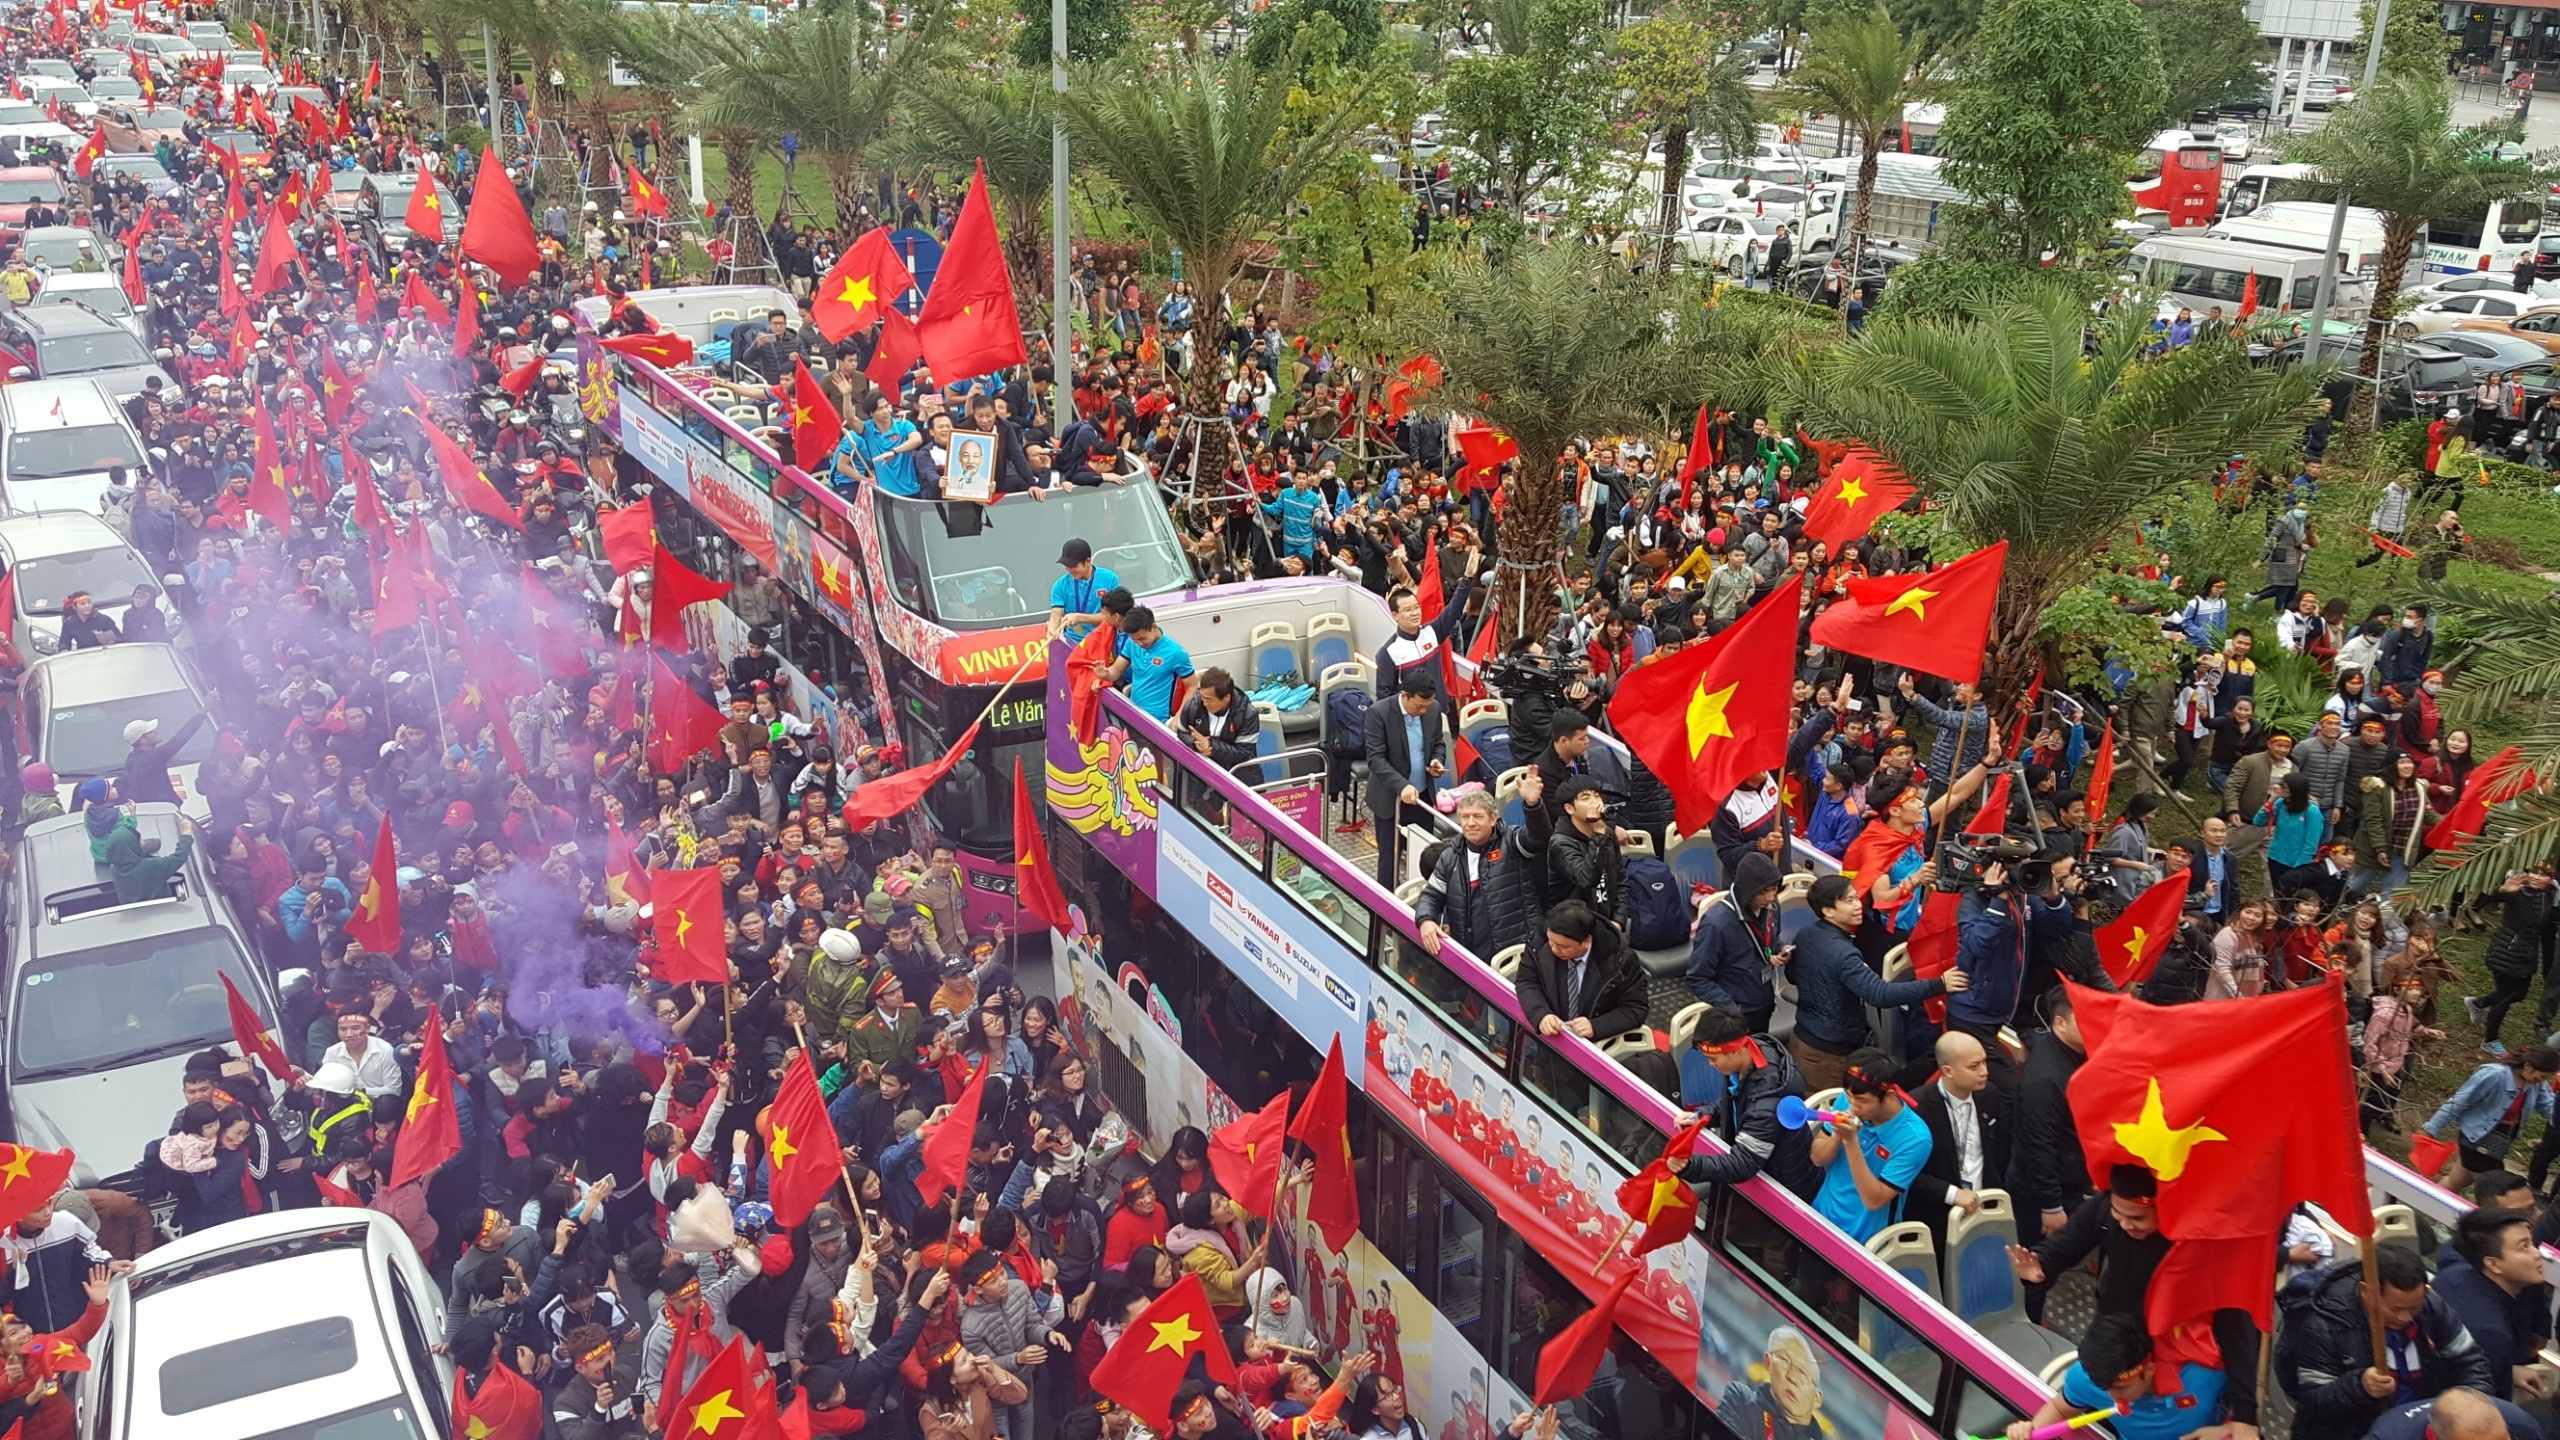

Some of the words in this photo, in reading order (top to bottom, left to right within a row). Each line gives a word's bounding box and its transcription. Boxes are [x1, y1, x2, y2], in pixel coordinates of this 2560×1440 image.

[2426, 249, 2468, 264] ETNAM
[957, 644, 1019, 676] VINH
[991, 703, 1010, 727] Lê
[1014, 699, 1044, 723] Văn
[1208, 876, 1232, 903] Z.com
[1247, 909, 1280, 944] YANMAR
[1266, 957, 1293, 986] SONY
[1292, 949, 1320, 979] SUZUKI
